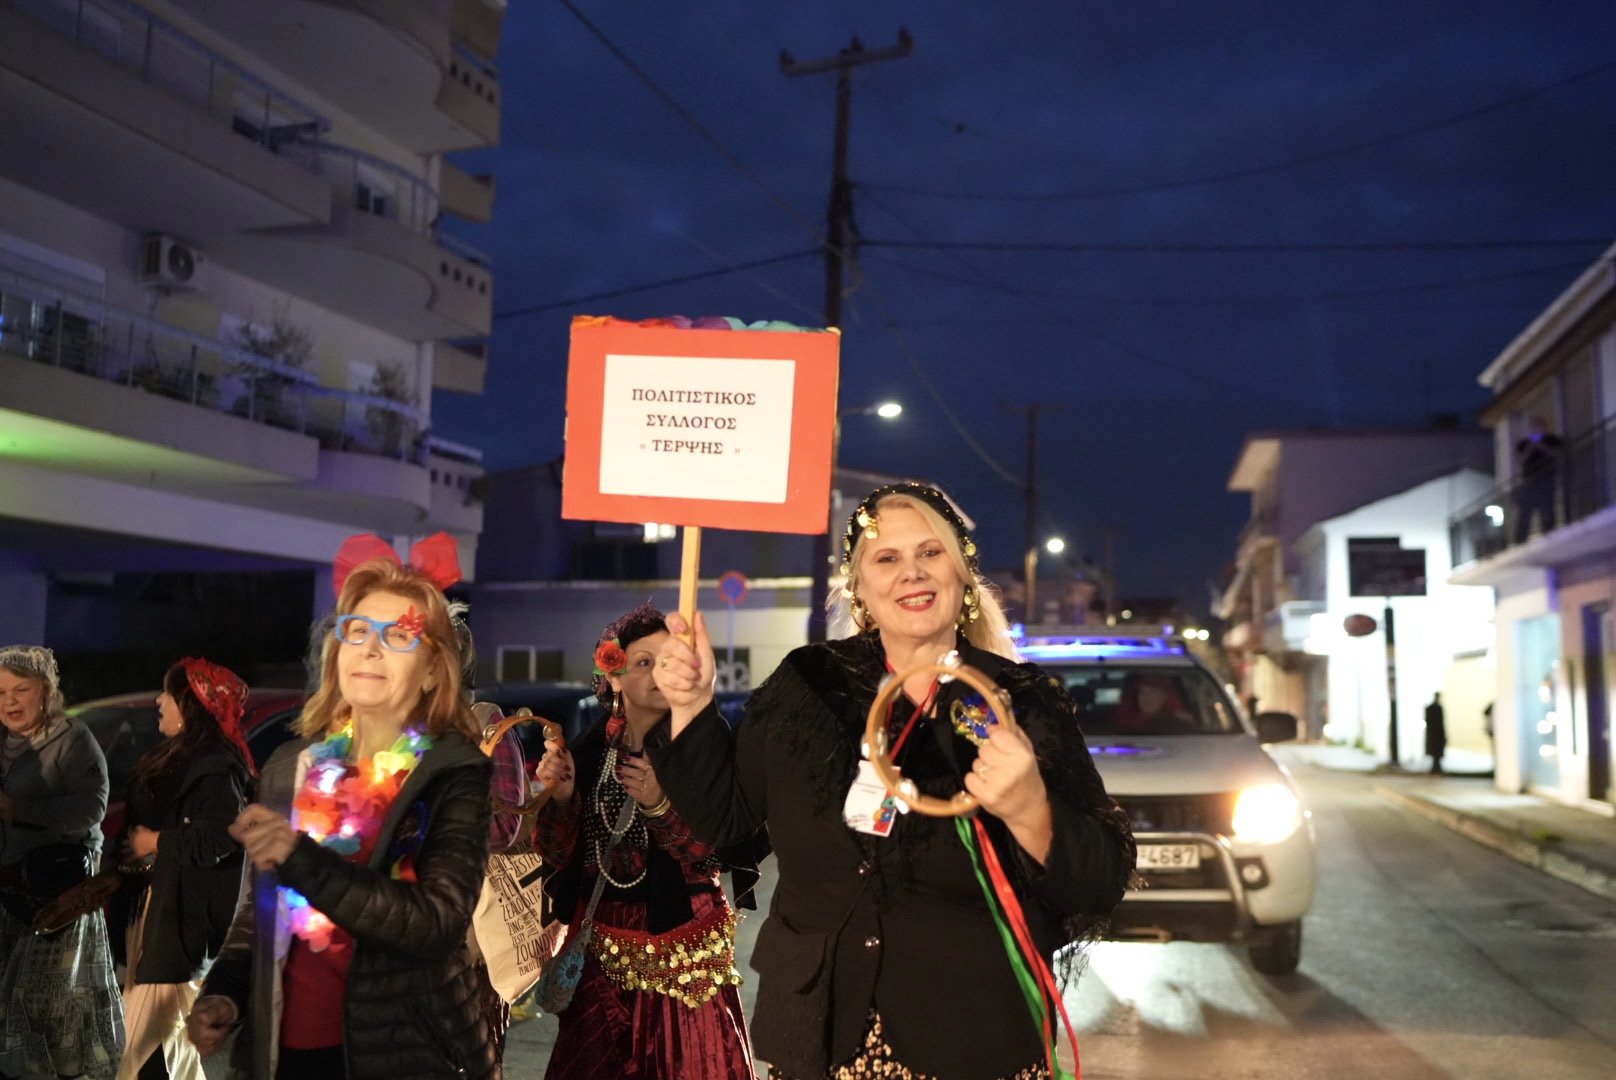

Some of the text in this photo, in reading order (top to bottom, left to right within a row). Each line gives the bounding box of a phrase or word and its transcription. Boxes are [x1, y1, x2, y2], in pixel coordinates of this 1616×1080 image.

[631, 388, 757, 406] ΠΟΛΙΤΙΣΤΙΚΟΣ
[646, 414, 737, 430] ΣΥΛΛΟΓΟΣ
[651, 439, 724, 455] ΤΕΡΨΗΣ
[511, 852, 542, 878] ZESTFU
[500, 888, 538, 921] ZEALOSLY
[506, 918, 525, 936] ZING
